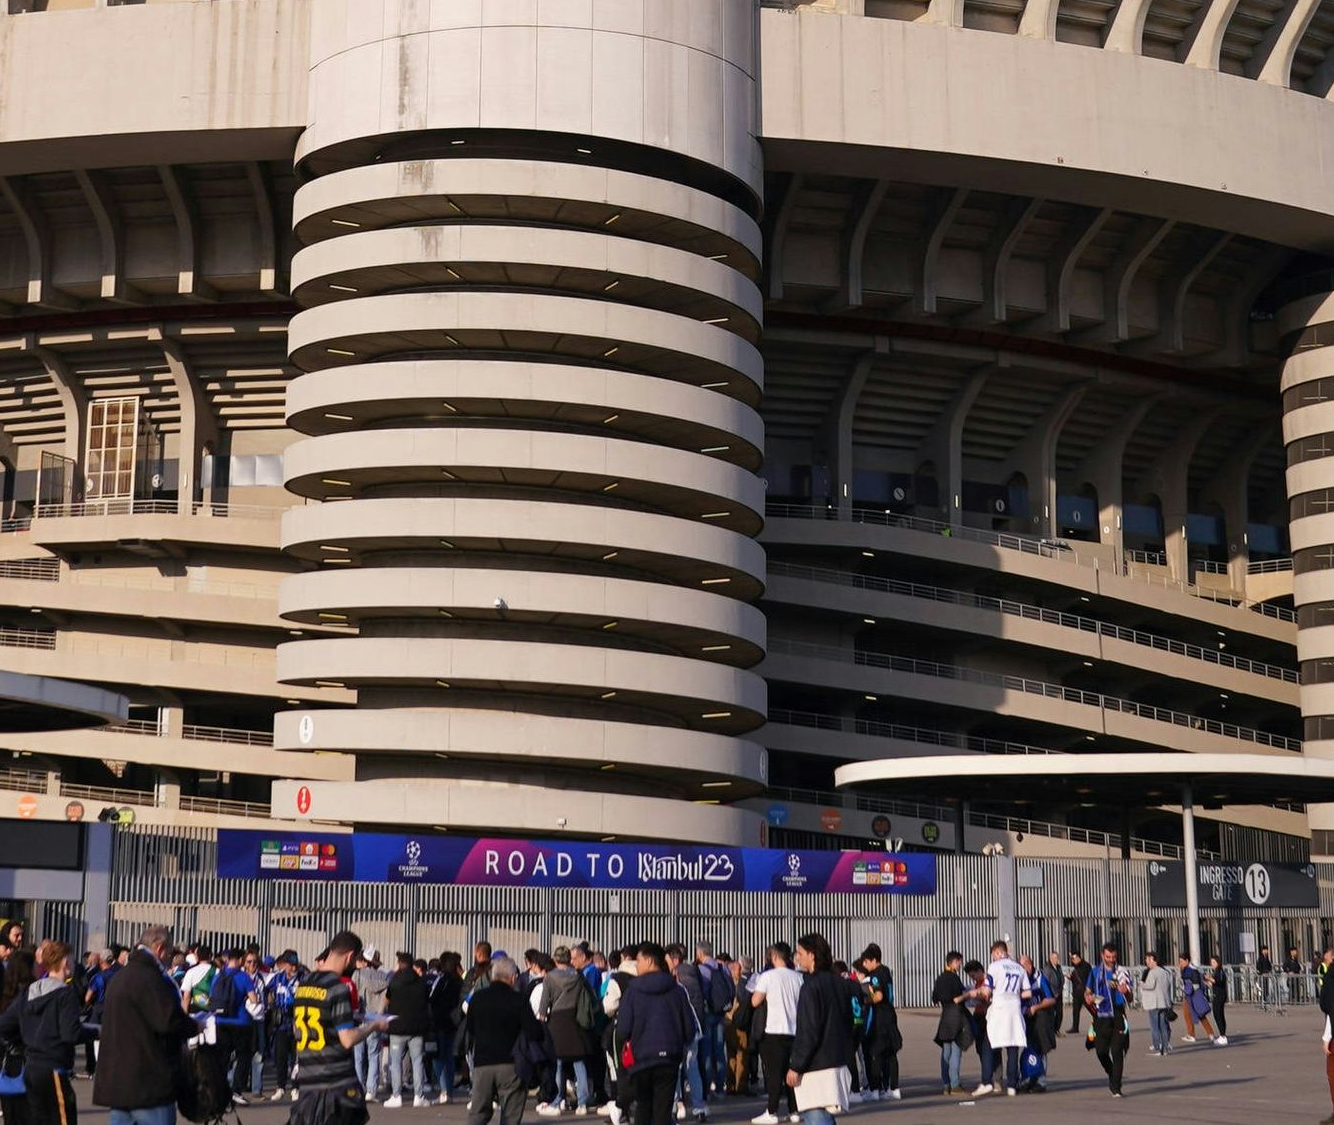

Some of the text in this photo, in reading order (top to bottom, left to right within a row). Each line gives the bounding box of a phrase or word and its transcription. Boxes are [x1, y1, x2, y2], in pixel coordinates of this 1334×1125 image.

[485, 849, 573, 877] ROAD
[586, 853, 624, 878] TO
[1200, 865, 1244, 885] INGRESSO
[1212, 884, 1233, 901] GATE
[1249, 869, 1267, 900] 13
[1005, 972, 1019, 992] 77
[294, 1005, 326, 1052] 33
